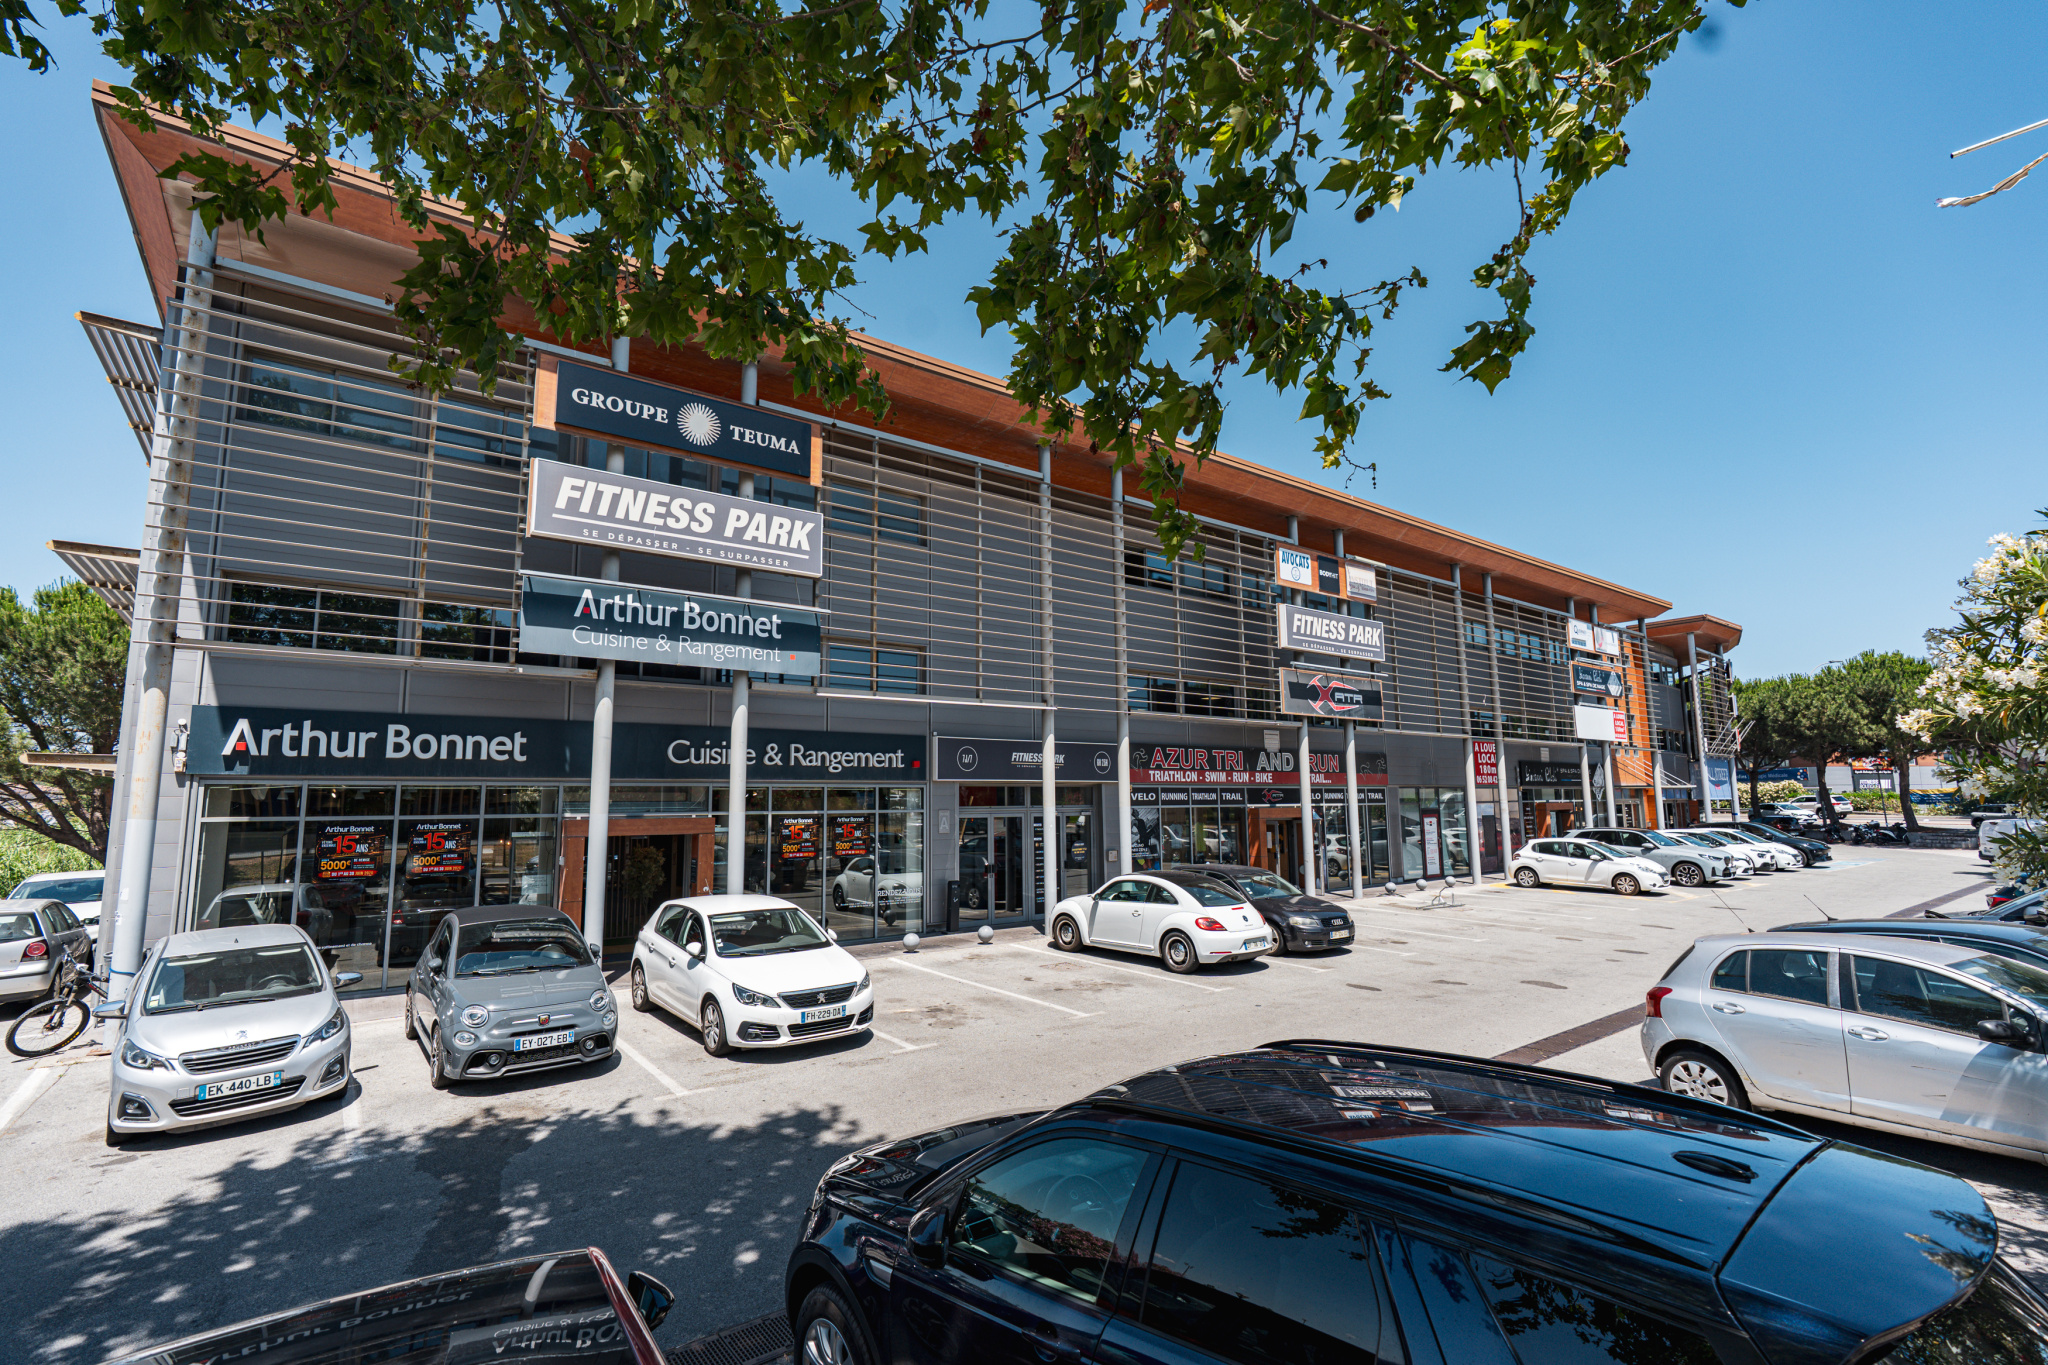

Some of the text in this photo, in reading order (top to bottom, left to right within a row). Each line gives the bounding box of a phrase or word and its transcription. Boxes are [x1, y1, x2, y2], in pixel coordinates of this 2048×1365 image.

[571, 388, 800, 454] GROUPE TEUMA
[554, 476, 815, 551] FITNESS PARK
[582, 529, 789, 568] SE DÉPASSER SE SURPASSER
[1281, 551, 1310, 570] AVOCATS
[573, 588, 782, 640] Arthur Bonnet
[1292, 613, 1382, 647] FITNESS PARK
[572, 625, 782, 662] Cuisine & Rangement
[221, 718, 528, 762] Arthur Bonnet
[1475, 743, 1496, 753] A LOUE
[667, 739, 905, 774] Cuisie & Rangement
[1011, 752, 1043, 763] FITNESS
[1150, 747, 1339, 773] AZUR TRI AND RUN
[1149, 770, 1198, 782] TRIATHLON
[1205, 771, 1226, 782] SWIM
[1232, 772, 1249, 783] RUN
[1255, 773, 1272, 783] BIKE
[789, 825, 804, 839] 15
[842, 824, 856, 838] 15
[940, 816, 949, 830] A
[333, 835, 369, 854] 15 ANS
[424, 832, 447, 850] 15
[445, 840, 456, 849] ANS
[320, 860, 351, 870] 5000€
[413, 856, 440, 865] 5000€
